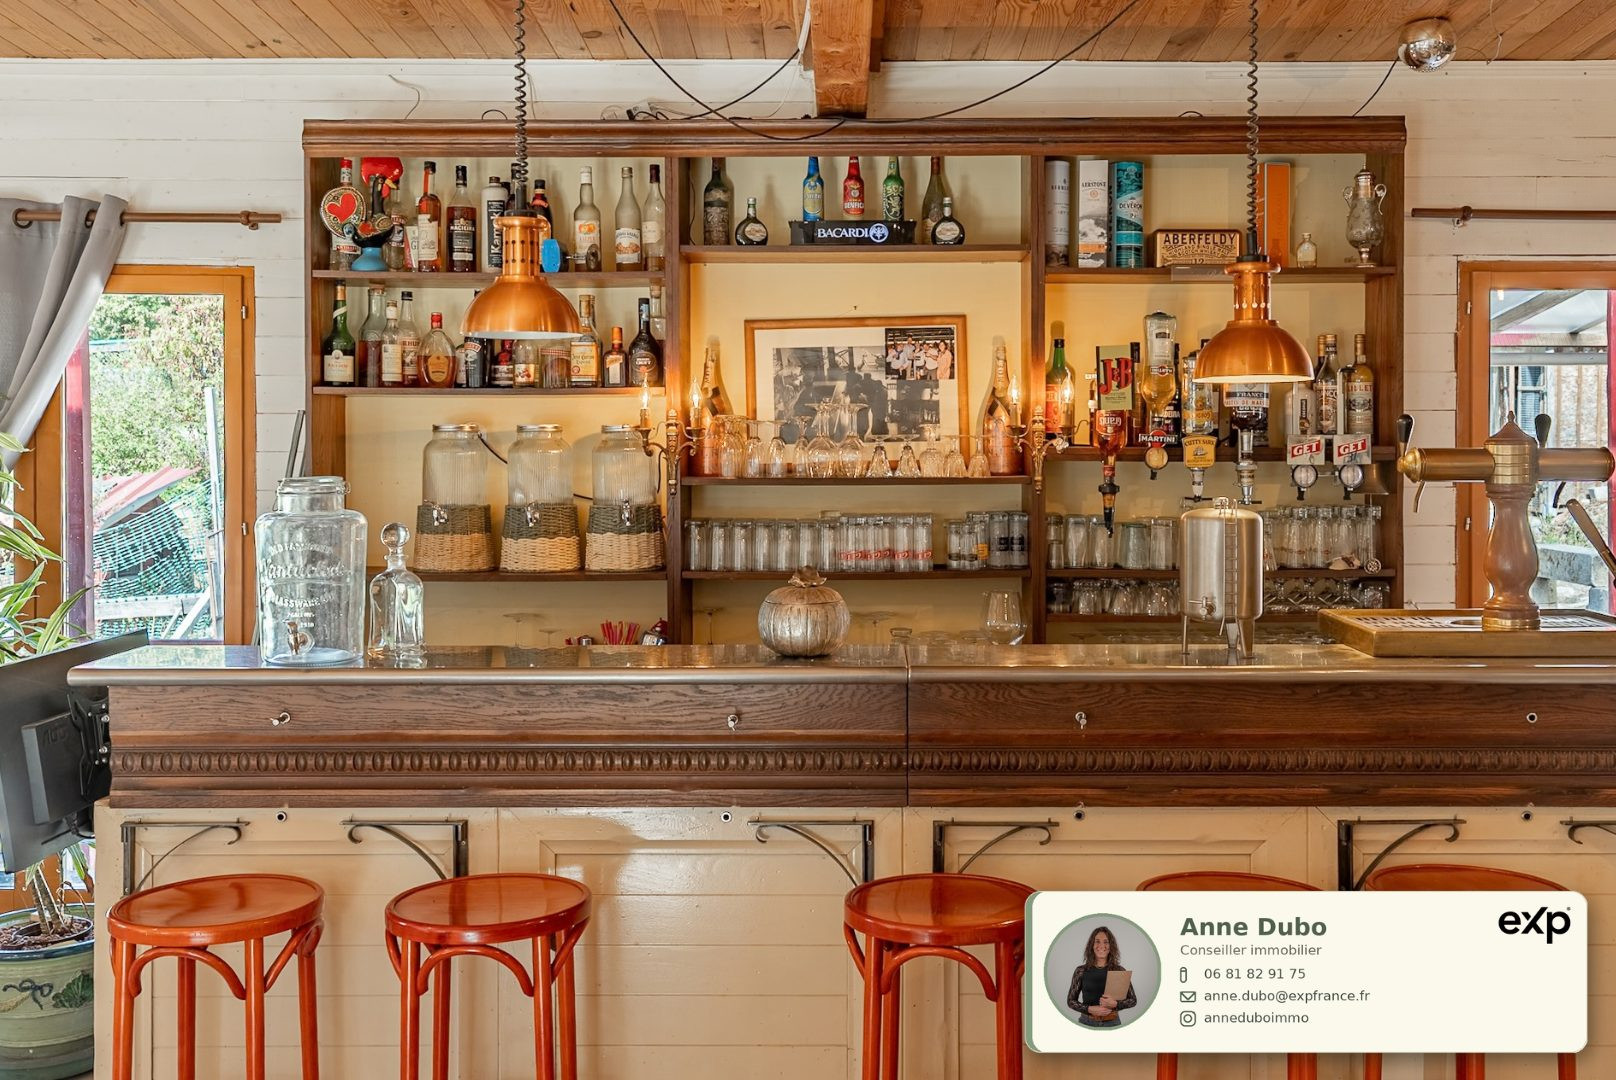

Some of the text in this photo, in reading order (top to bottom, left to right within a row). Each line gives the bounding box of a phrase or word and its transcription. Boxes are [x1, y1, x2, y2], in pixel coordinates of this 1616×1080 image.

[817, 228, 869, 238] BACARDI
[1163, 233, 1237, 245] ABERFELDY
[1099, 357, 1133, 395] J&B
[1141, 435, 1175, 443] MARTINI
[1184, 438, 1215, 447] CUTTY SARK
[1292, 441, 1321, 456] GET
[1339, 439, 1366, 455] GET
